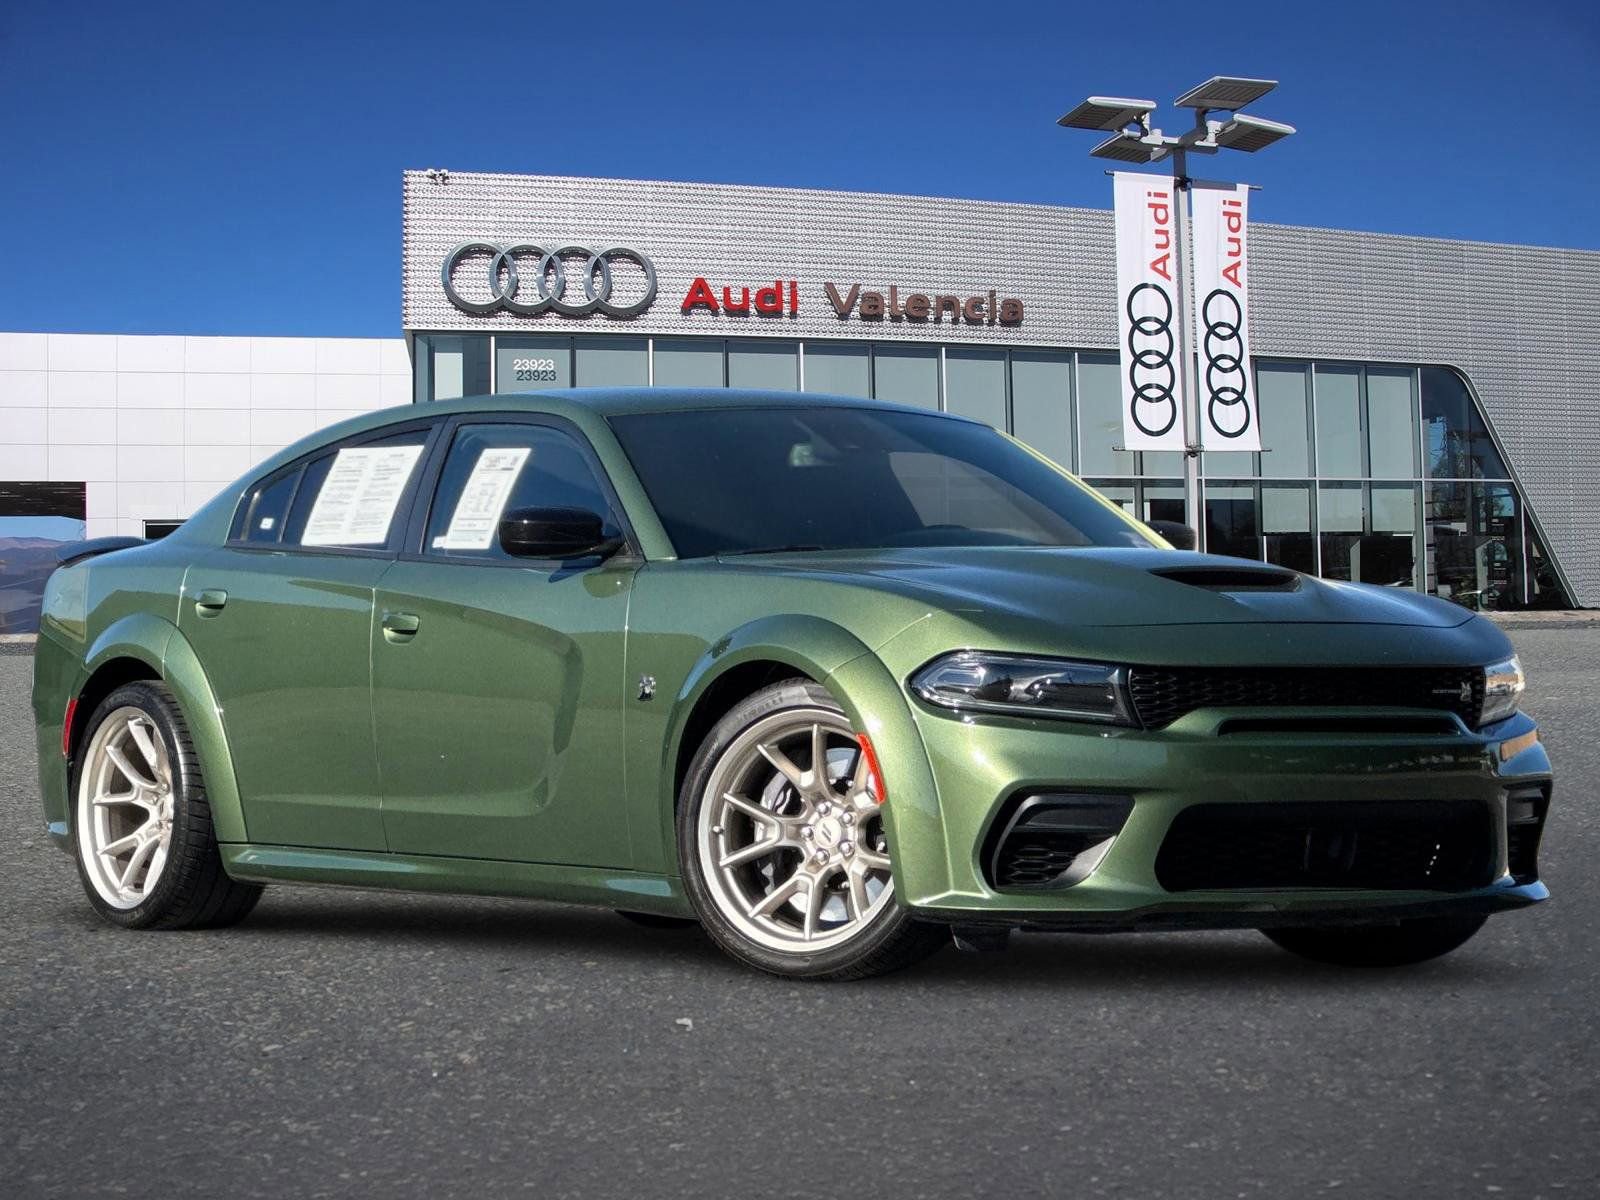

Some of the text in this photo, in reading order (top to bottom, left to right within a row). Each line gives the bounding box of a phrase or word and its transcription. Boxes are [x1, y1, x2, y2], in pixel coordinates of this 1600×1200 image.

[1148, 191, 1172, 282] Audi
[1222, 200, 1243, 288] Audi
[682, 277, 1024, 326] Audi Valencia
[513, 358, 555, 371] 23923
[516, 370, 557, 382] 23923
